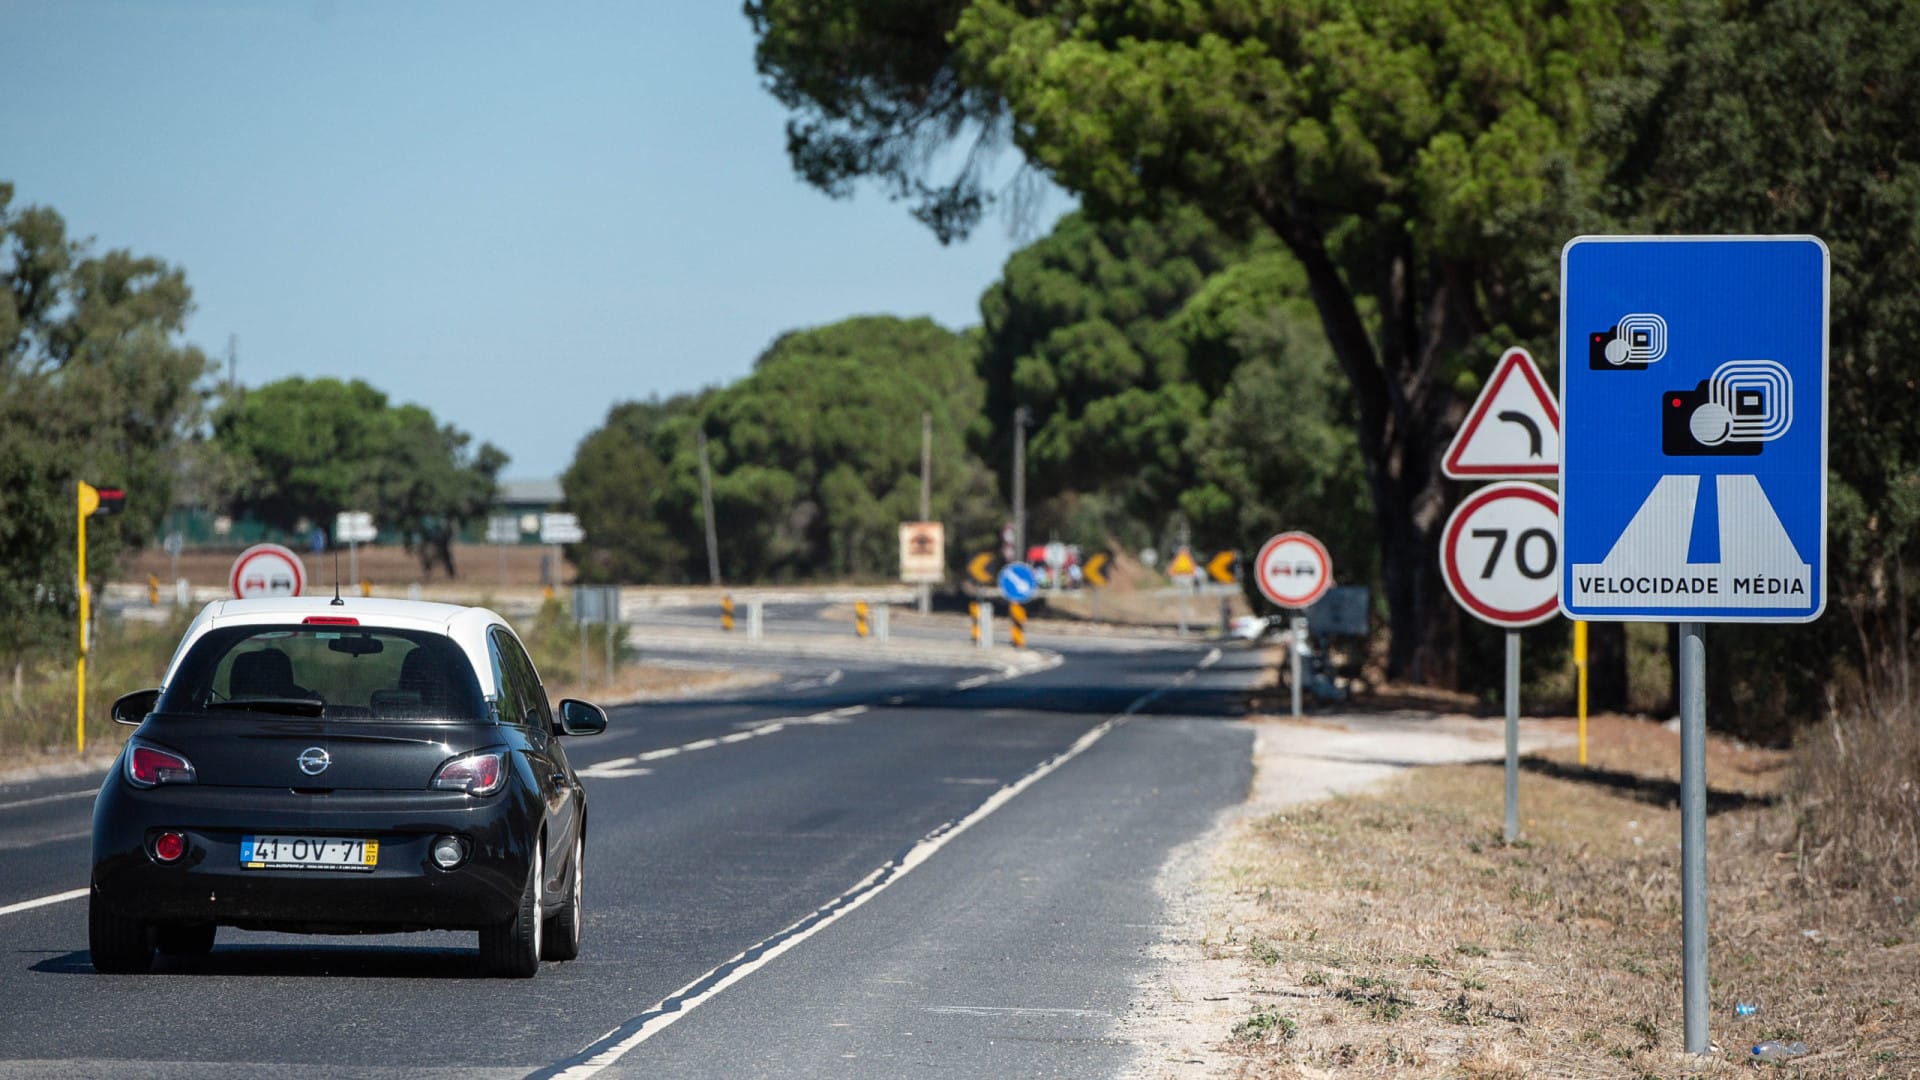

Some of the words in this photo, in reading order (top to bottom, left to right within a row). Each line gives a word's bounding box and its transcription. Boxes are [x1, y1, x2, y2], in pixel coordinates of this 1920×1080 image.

[1471, 528, 1558, 580] 70
[1578, 577, 1719, 594] VELOCIDADE
[1732, 574, 1805, 595] MÉDIA
